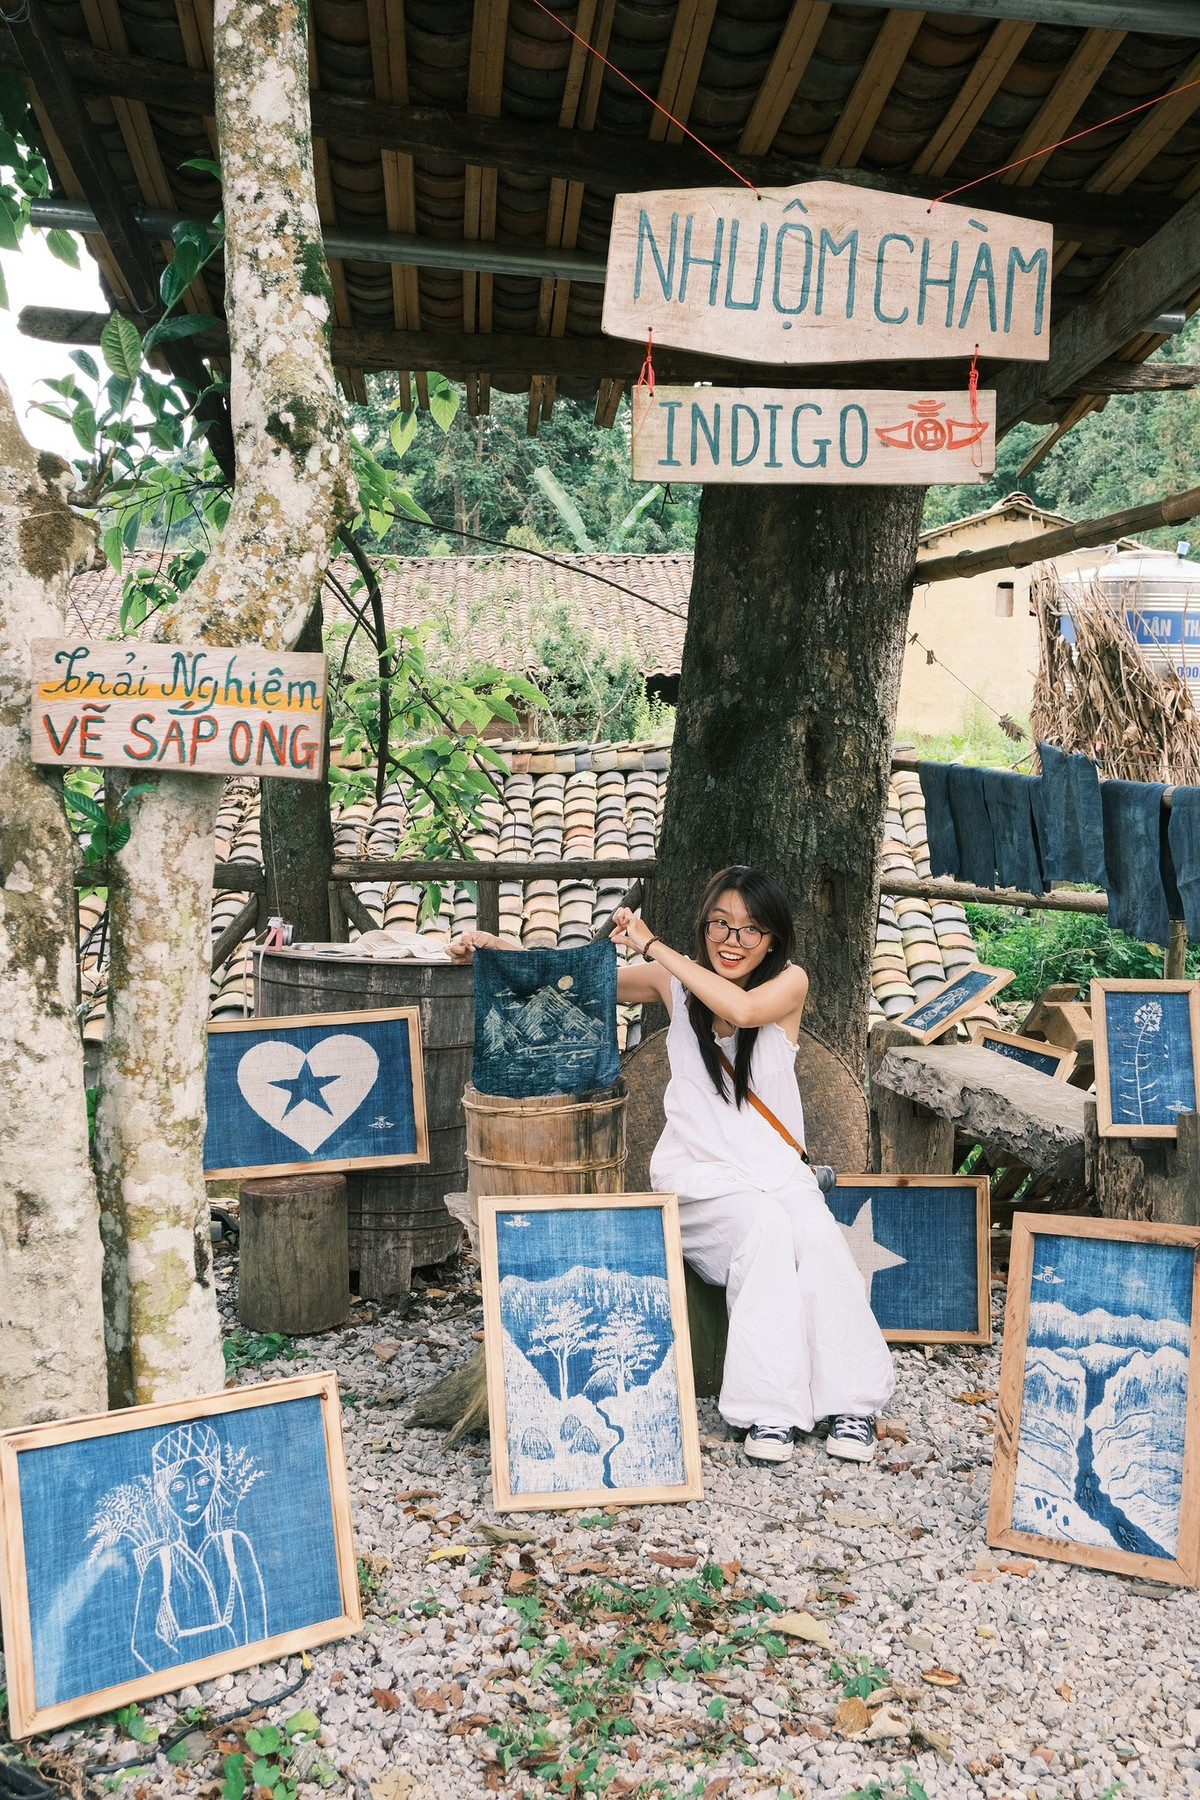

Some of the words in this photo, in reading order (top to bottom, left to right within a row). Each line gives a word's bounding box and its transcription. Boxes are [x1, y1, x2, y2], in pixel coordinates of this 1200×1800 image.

[634, 198, 859, 330] NHUỘM
[874, 219, 1048, 335] CHÀM
[658, 401, 869, 469] INDIGO
[1183, 619, 1200, 637] TH
[43, 646, 150, 697] Trải
[160, 651, 321, 714] Nghiệm
[42, 703, 111, 760] VẼ
[123, 701, 219, 767] SÁP
[229, 720, 319, 770] ONG
